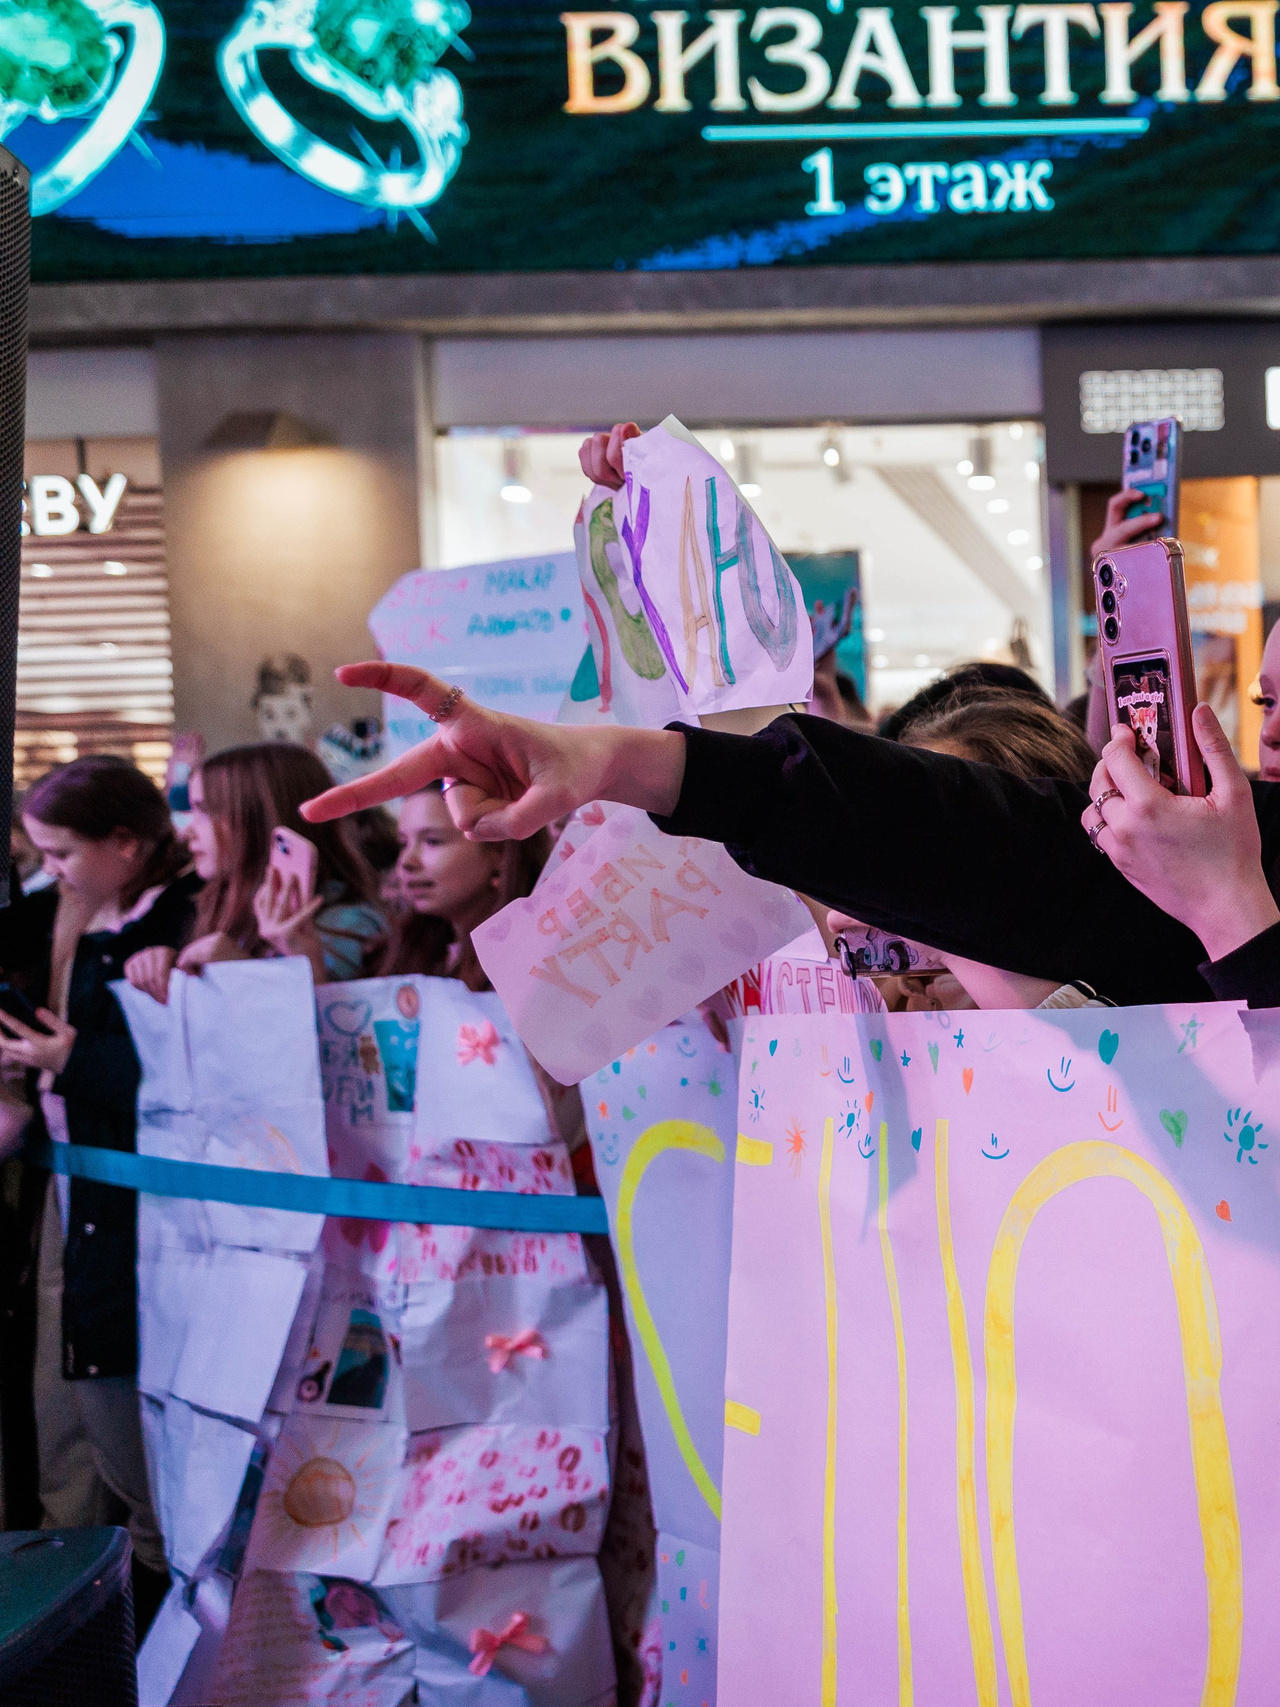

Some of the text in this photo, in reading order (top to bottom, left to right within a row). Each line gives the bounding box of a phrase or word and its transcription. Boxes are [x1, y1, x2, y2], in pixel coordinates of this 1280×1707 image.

[801, 147, 1055, 215] 1 этаж
[21, 472, 128, 536] BY
